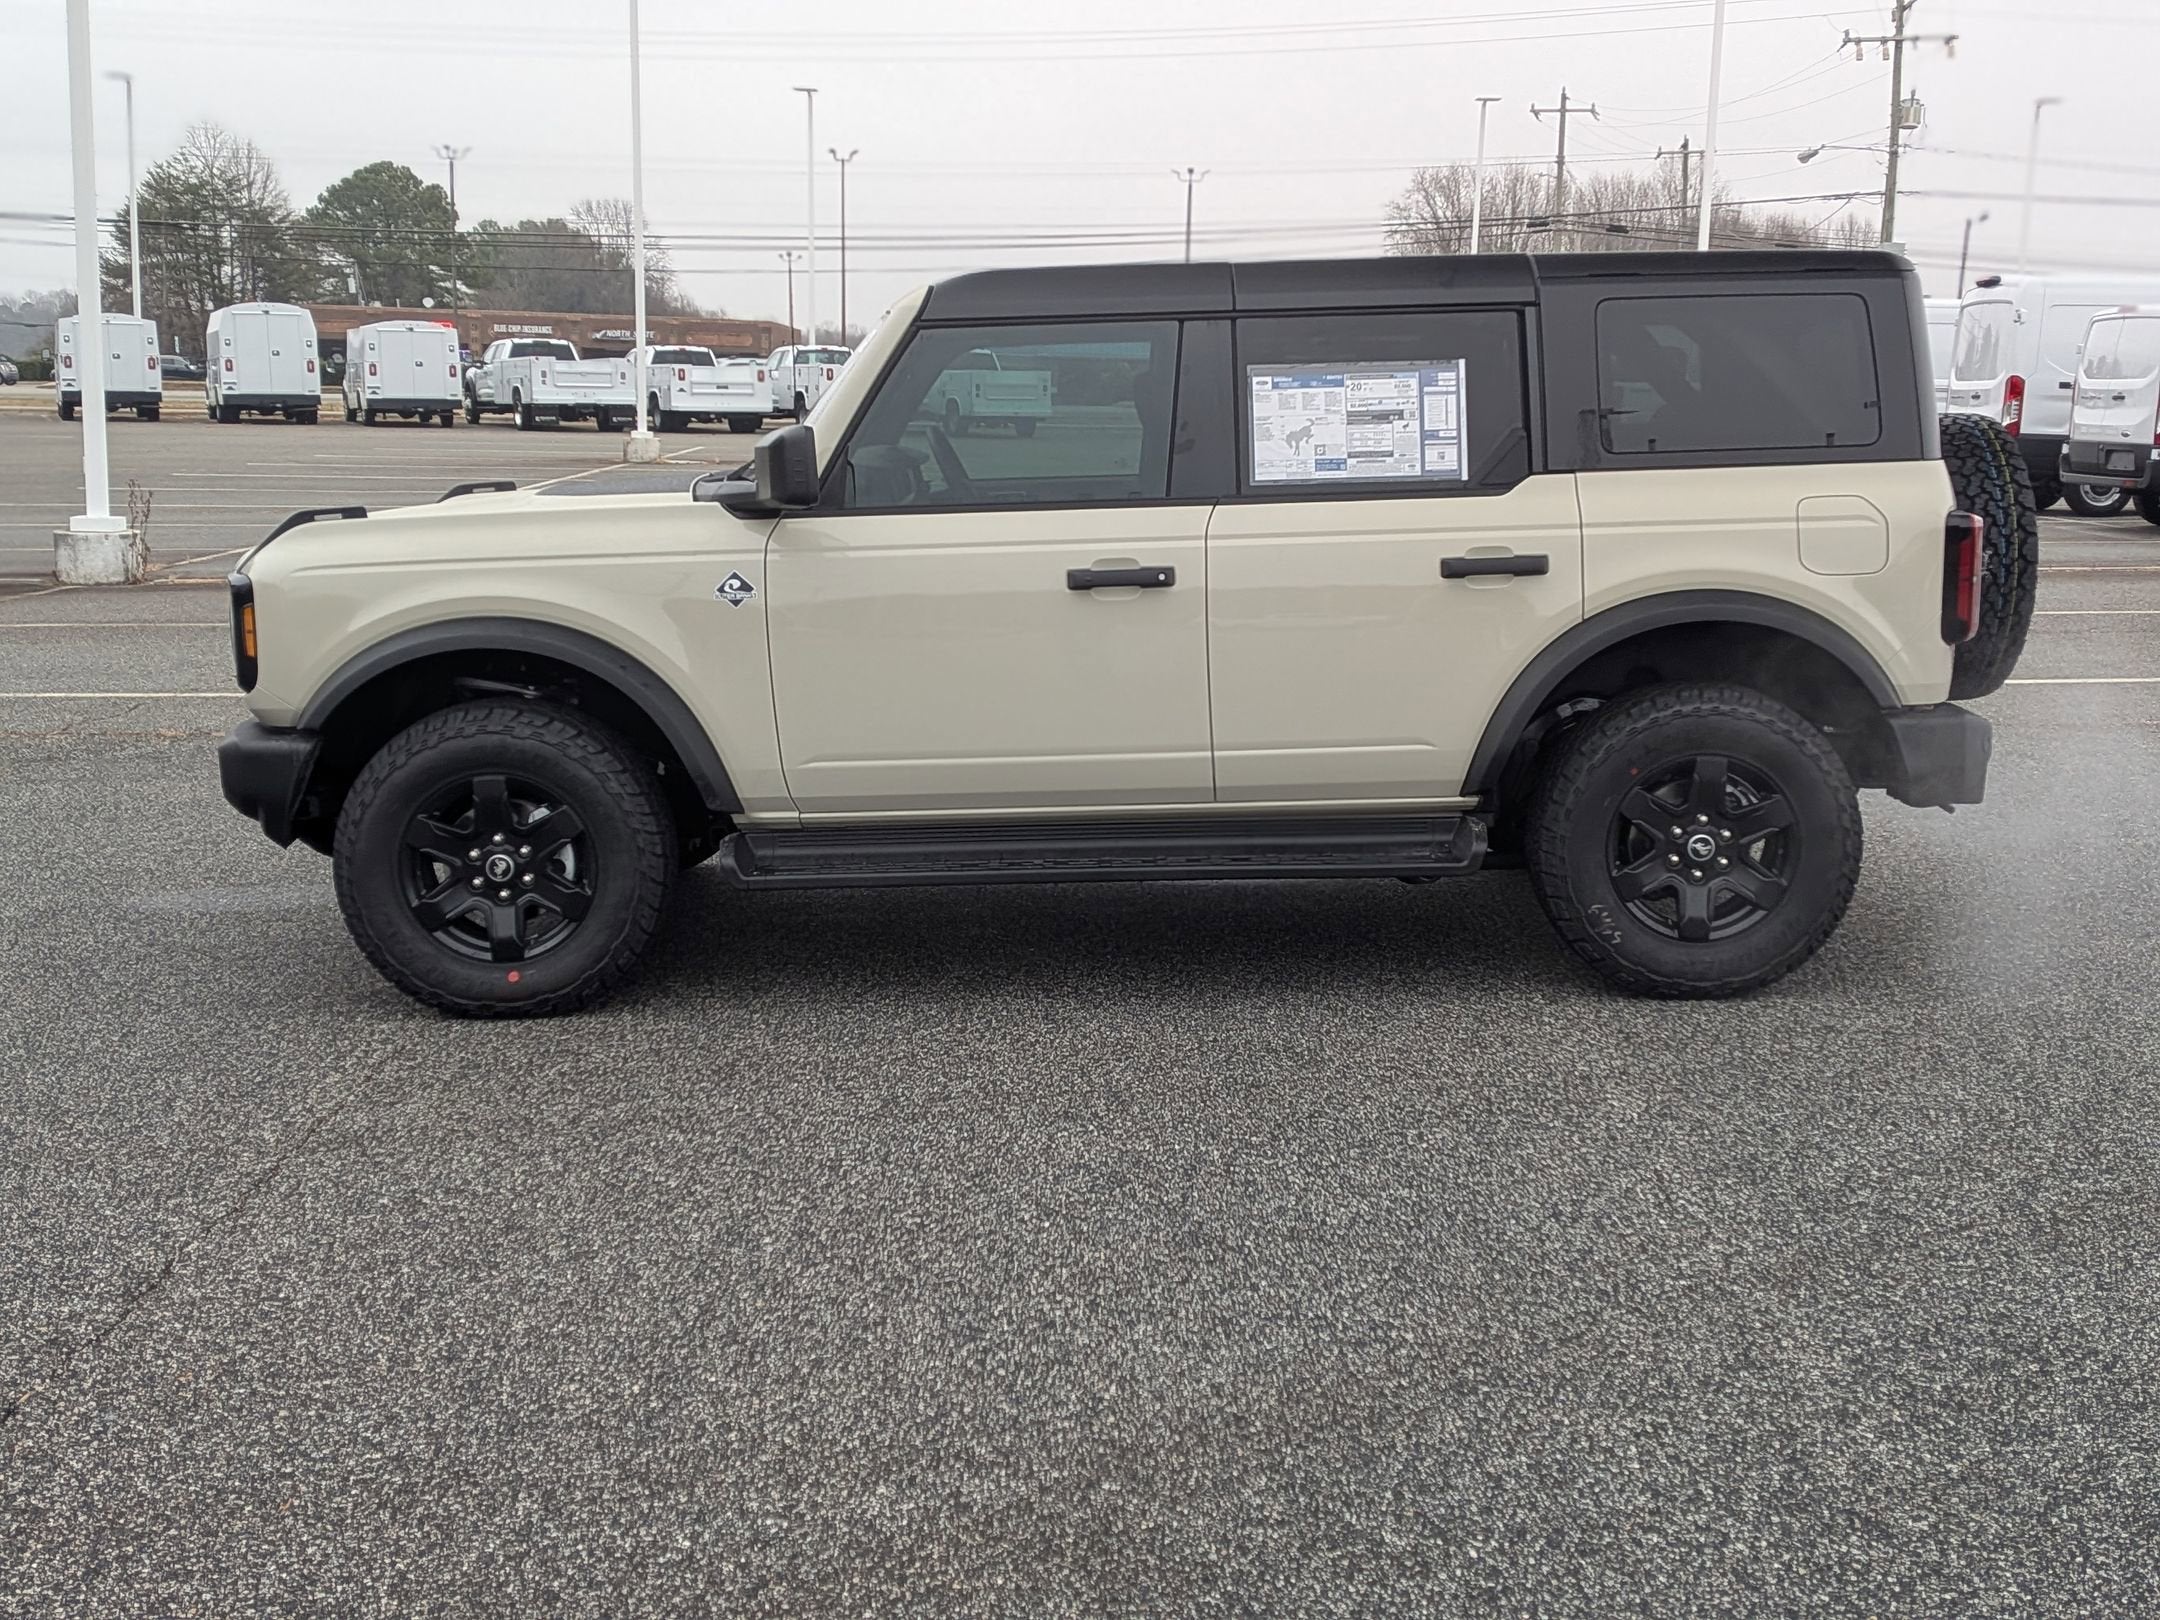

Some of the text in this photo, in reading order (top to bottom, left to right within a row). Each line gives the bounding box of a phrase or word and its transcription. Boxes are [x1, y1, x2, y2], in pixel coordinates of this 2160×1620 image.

[494, 324, 552, 334] BLUE CHIP INSURANCE
[606, 329, 656, 339] NORTH STE
[1350, 382, 1362, 391] 20
